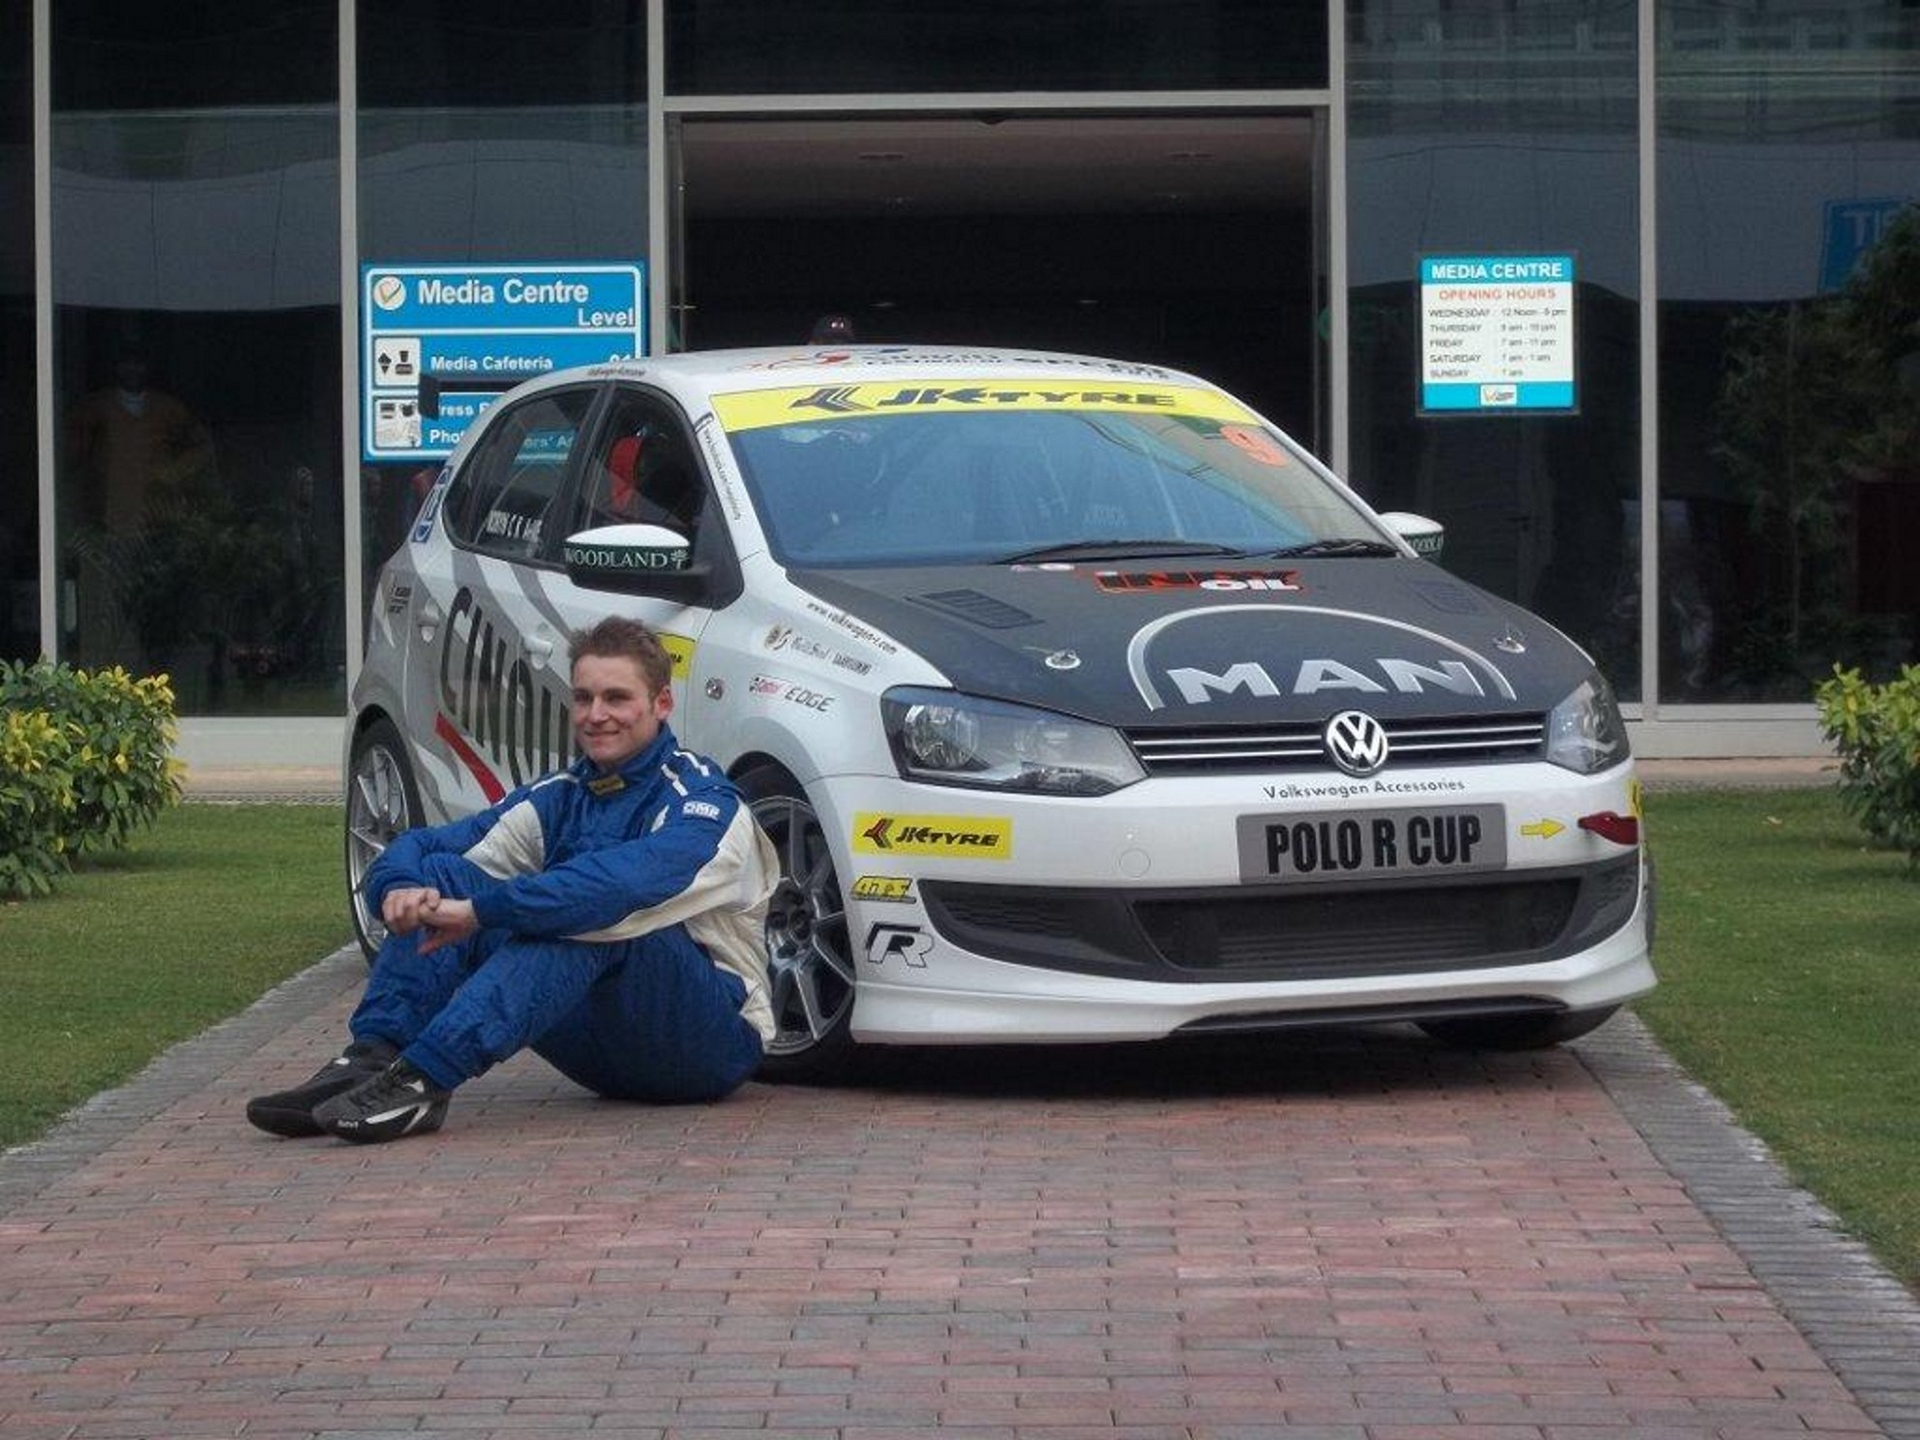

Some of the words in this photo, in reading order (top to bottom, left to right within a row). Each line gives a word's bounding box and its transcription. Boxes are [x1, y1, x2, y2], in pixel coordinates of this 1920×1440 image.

[1432, 264, 1487, 279] MEDIA
[1492, 263, 1562, 278] CENTRE
[419, 279, 494, 304] Media
[503, 279, 588, 304] Centre
[1439, 289, 1502, 301] OPENING
[1506, 288, 1556, 300] HOURS
[578, 308, 635, 327] Level
[1428, 308, 1490, 318] WEDNESDAY
[1429, 324, 1482, 333] THURSDAY
[1429, 339, 1463, 348] FRIDAY
[431, 356, 478, 371] Media
[483, 355, 553, 371] Cafeteria
[1429, 354, 1482, 363] SATURDAY
[1429, 370, 1470, 379] SUNDAY
[441, 405, 474, 417] ress
[1167, 657, 1486, 706] MAN
[784, 687, 835, 713] EDGE
[1263, 782, 1370, 802] Volkswagen
[1373, 779, 1466, 795] Accessories
[1265, 819, 1363, 875] POLO
[1373, 818, 1397, 869] R
[1407, 814, 1481, 867] CUP
[866, 921, 935, 968] R
